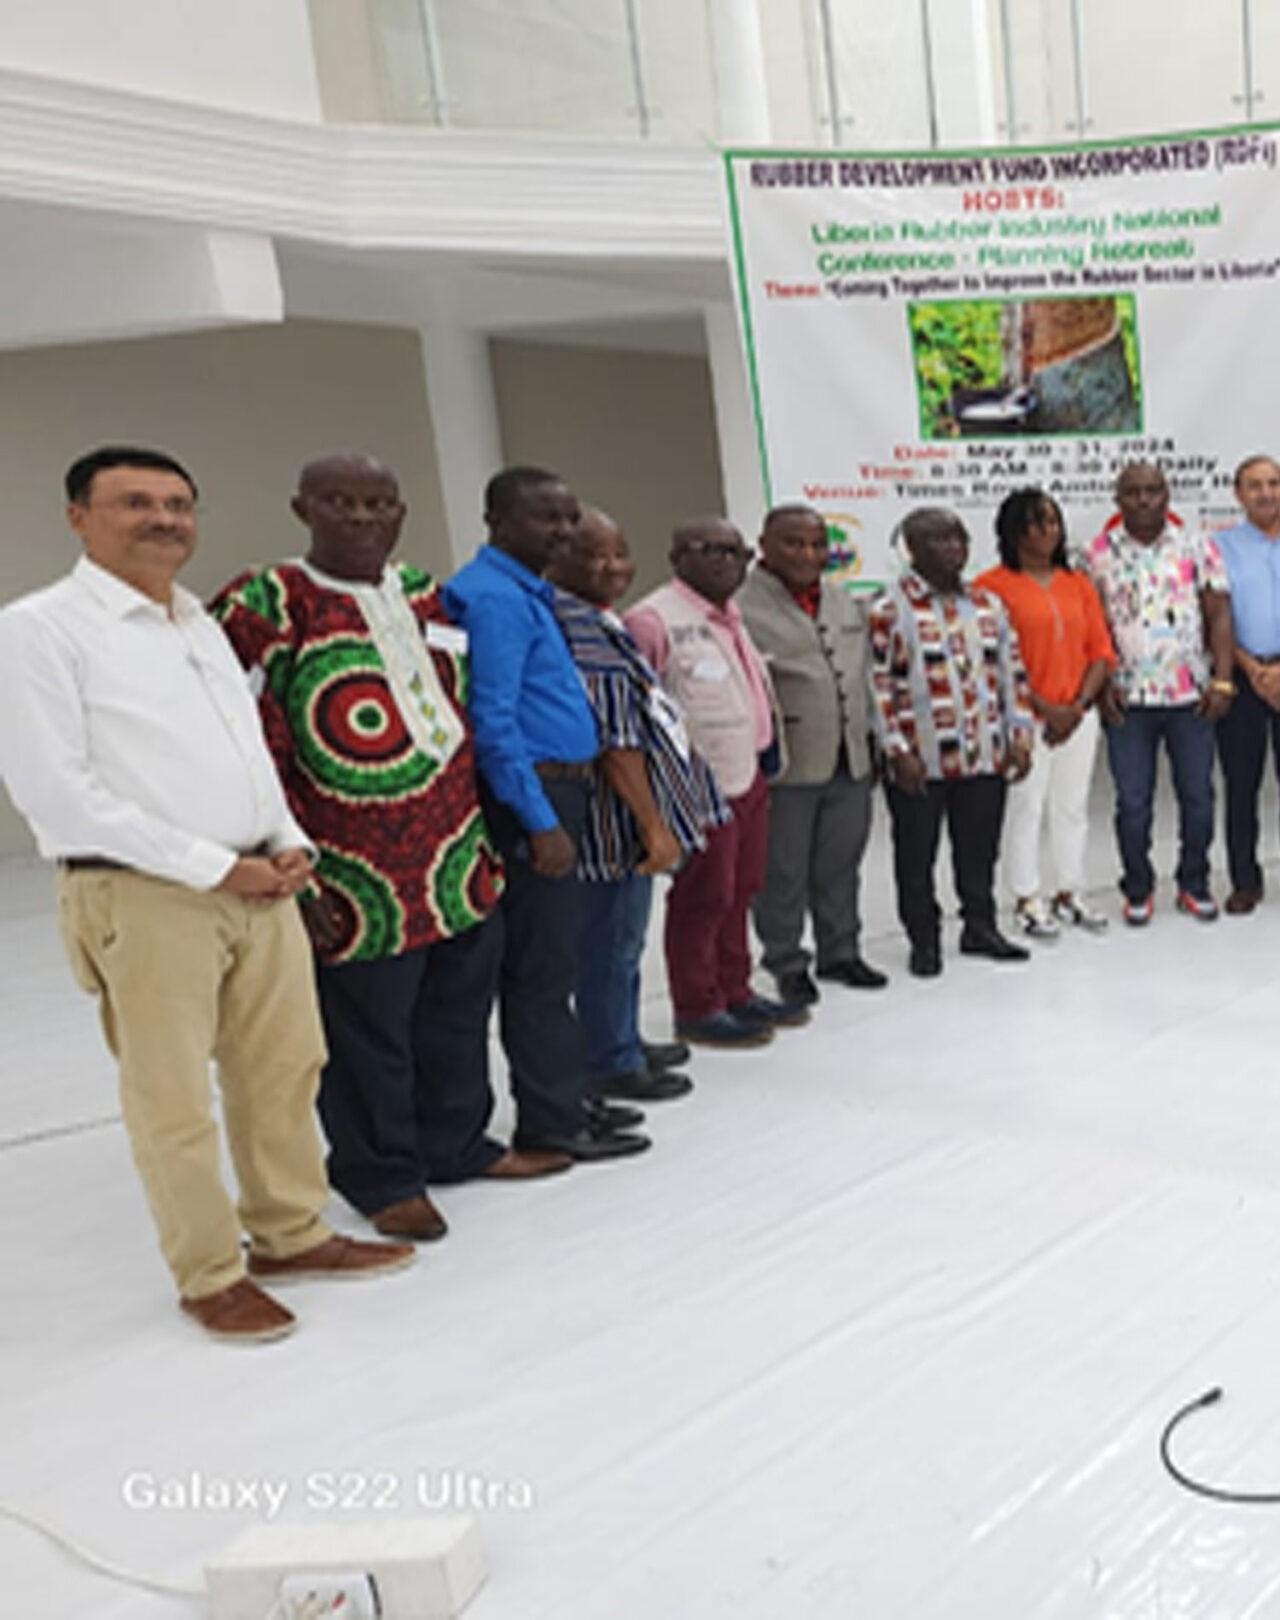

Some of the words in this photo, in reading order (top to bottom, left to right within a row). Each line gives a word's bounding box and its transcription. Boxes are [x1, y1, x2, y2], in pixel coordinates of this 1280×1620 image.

[750, 161, 833, 187] RUBBER
[839, 158, 984, 187] DEVELOPMENT
[991, 154, 1048, 181] FUND
[1050, 140, 1211, 179] INCORPORATED
[963, 187, 1065, 211] HOSTS:
[811, 221, 893, 244] Liberia
[901, 218, 991, 241] Rubber
[1000, 214, 1105, 238] Industry
[1113, 203, 1222, 231] National
[817, 250, 955, 275] Conference
[979, 244, 1084, 268] Planning
[764, 281, 820, 298] Theme:
[891, 276, 959, 296] Together
[964, 275, 979, 290] to
[984, 271, 1046, 293] Improve
[1051, 270, 1077, 285] the
[1082, 267, 1138, 284] Rubber
[1143, 263, 1195, 283] Sector
[1202, 263, 1215, 280] in
[893, 445, 956, 461] Date:
[967, 444, 1015, 459] May
[1025, 442, 1051, 456] 30
[1119, 438, 1175, 453] 2024
[859, 465, 924, 480] Time:
[988, 461, 1028, 475] AM
[1156, 456, 1218, 472] Daily
[803, 484, 884, 500] Venue:
[895, 483, 964, 498] Times
